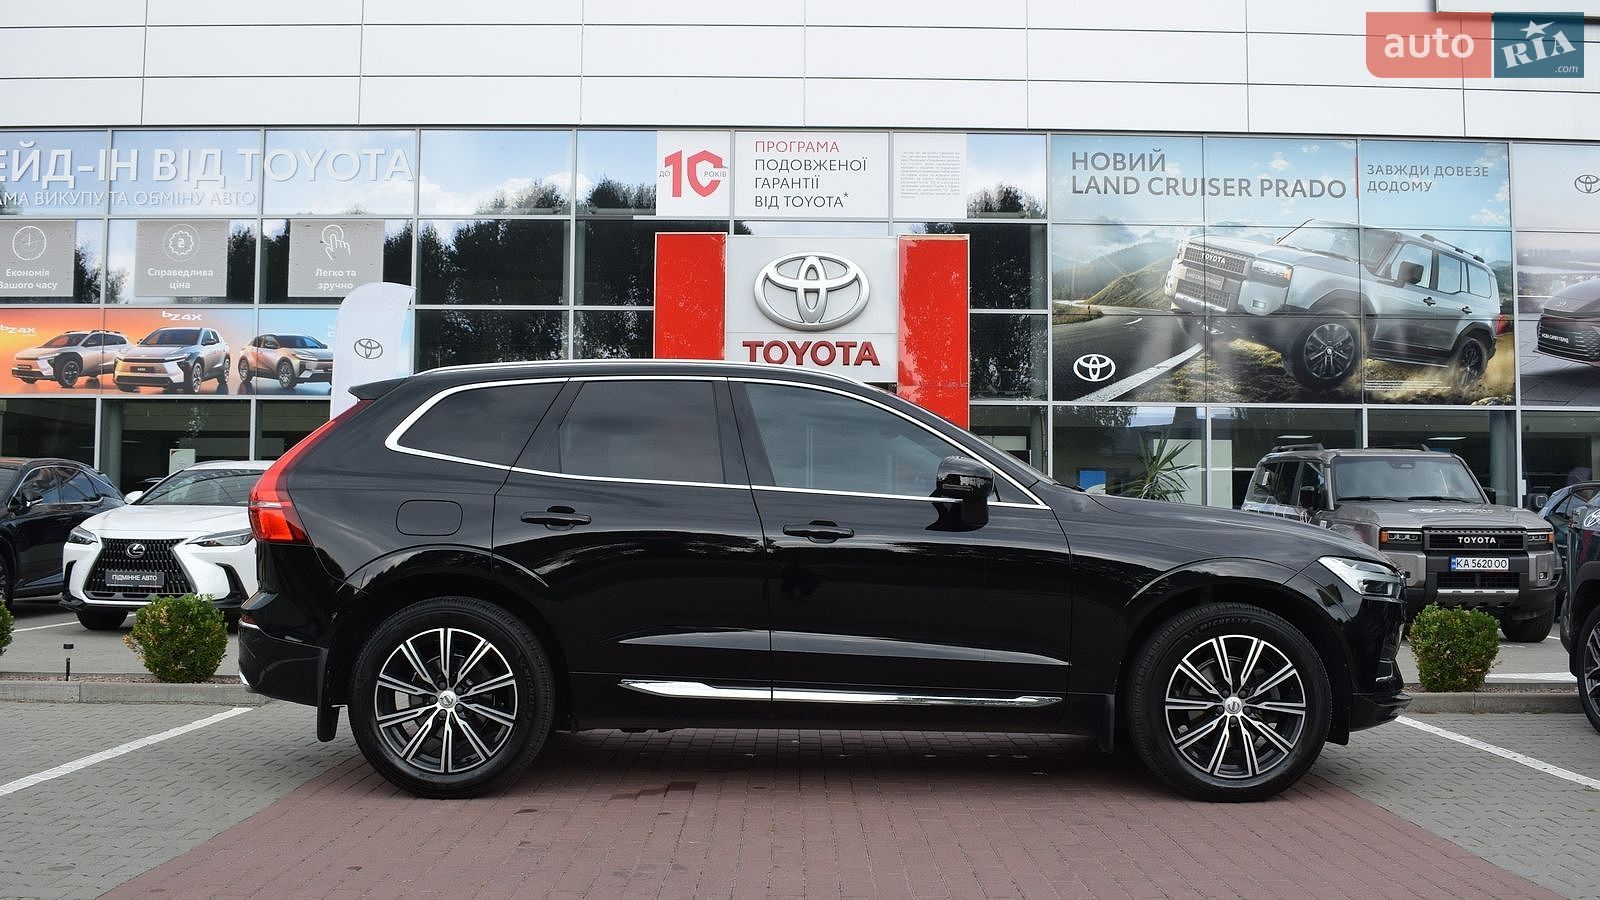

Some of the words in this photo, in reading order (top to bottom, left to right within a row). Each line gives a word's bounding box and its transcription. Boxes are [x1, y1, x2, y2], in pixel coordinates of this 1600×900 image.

[755, 140, 840, 153] ПРОГРАМА
[755, 156, 868, 173] ПОДОВЖЕНОЇ
[1071, 147, 1166, 172] НОВИЙ
[152, 148, 226, 189] ВІД
[237, 148, 416, 182] TOYOTA
[659, 170, 671, 178] ДО
[704, 170, 727, 178] РОКІВ
[1367, 164, 1430, 178] ЗАВЖДИ
[1434, 165, 1489, 179] ДОВЕЗЕ
[755, 174, 820, 189] ГАРАНТІЇ
[1071, 175, 1141, 195] LAND
[1147, 176, 1253, 197] CRUISER
[1260, 178, 1347, 199] PRADO
[1366, 180, 1433, 194] ДОДОМУ
[35, 191, 105, 206] ВИКУПУ
[110, 191, 129, 206] ТА
[210, 191, 256, 206] АВТО
[754, 196, 780, 209] ВІД
[6, 268, 51, 277] Економія
[147, 267, 214, 279] Справедлива
[315, 268, 344, 277] Легко
[35, 282, 58, 291] часу
[169, 280, 191, 290] ціна
[317, 282, 354, 291] зручно
[742, 339, 881, 367] TOYOTA
[1457, 536, 1497, 544] TOYOTA
[1471, 559, 1493, 569] 5620
